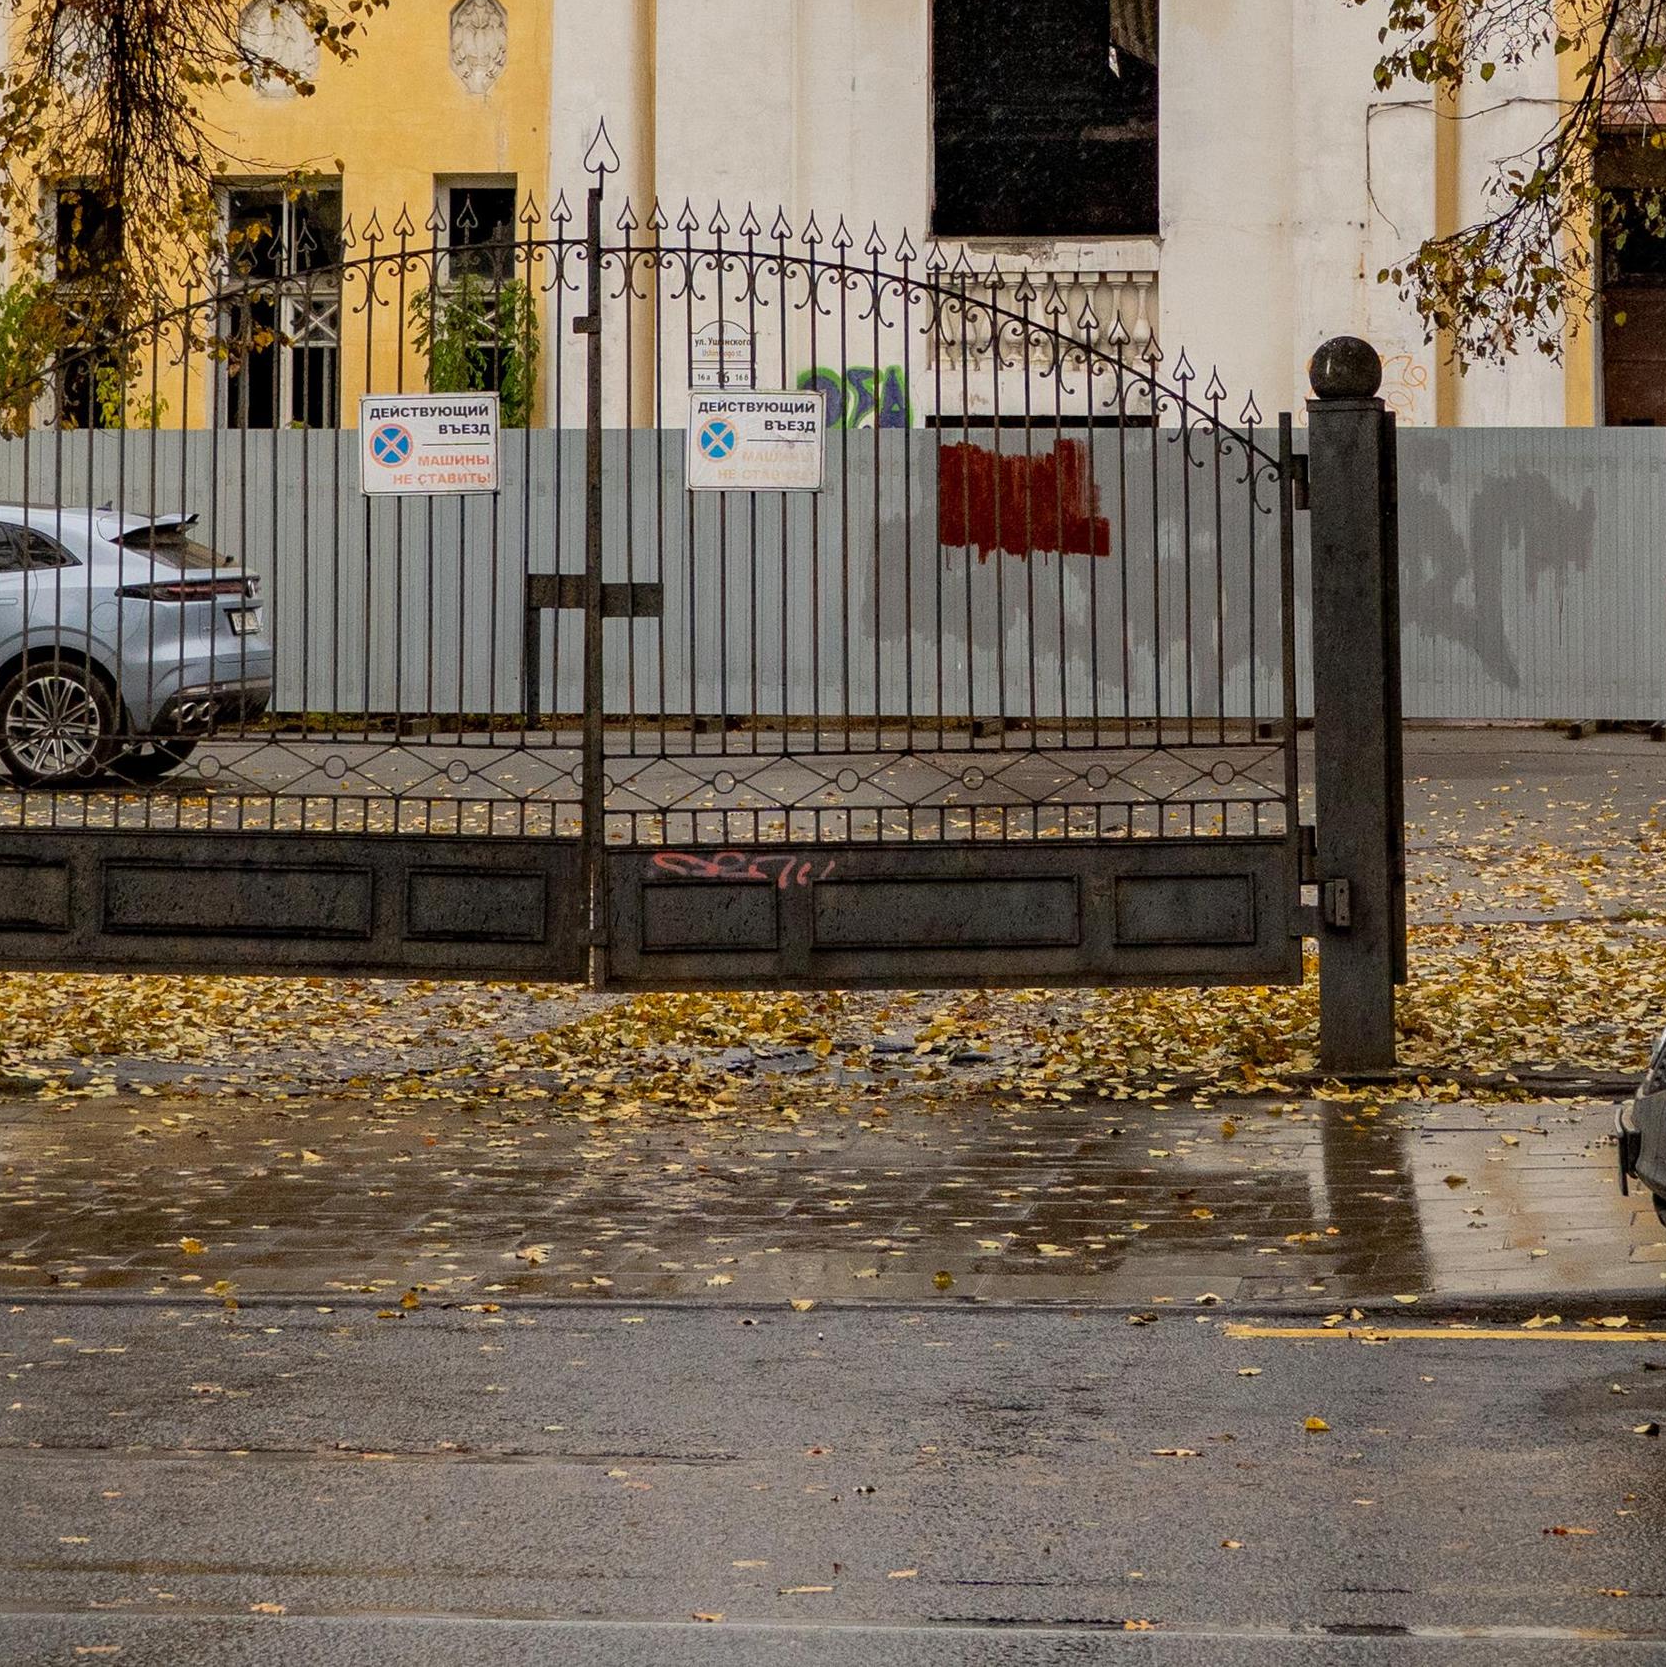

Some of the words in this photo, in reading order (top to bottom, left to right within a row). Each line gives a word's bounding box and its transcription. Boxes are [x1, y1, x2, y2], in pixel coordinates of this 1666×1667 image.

[694, 338, 707, 347] ул.
[708, 337, 751, 347] Ушнского
[369, 405, 489, 420] ДЕЙСТВУЮЩИЙ
[698, 400, 816, 415] ДЕЙСТВУЮЩИЙ
[438, 423, 490, 435] ВЪЕЗД
[764, 420, 816, 433] ВЪЕЗД
[417, 454, 490, 466] МАШИНЫ
[392, 474, 413, 485] НЕ
[417, 472, 491, 485] СТАВИТЬ!
